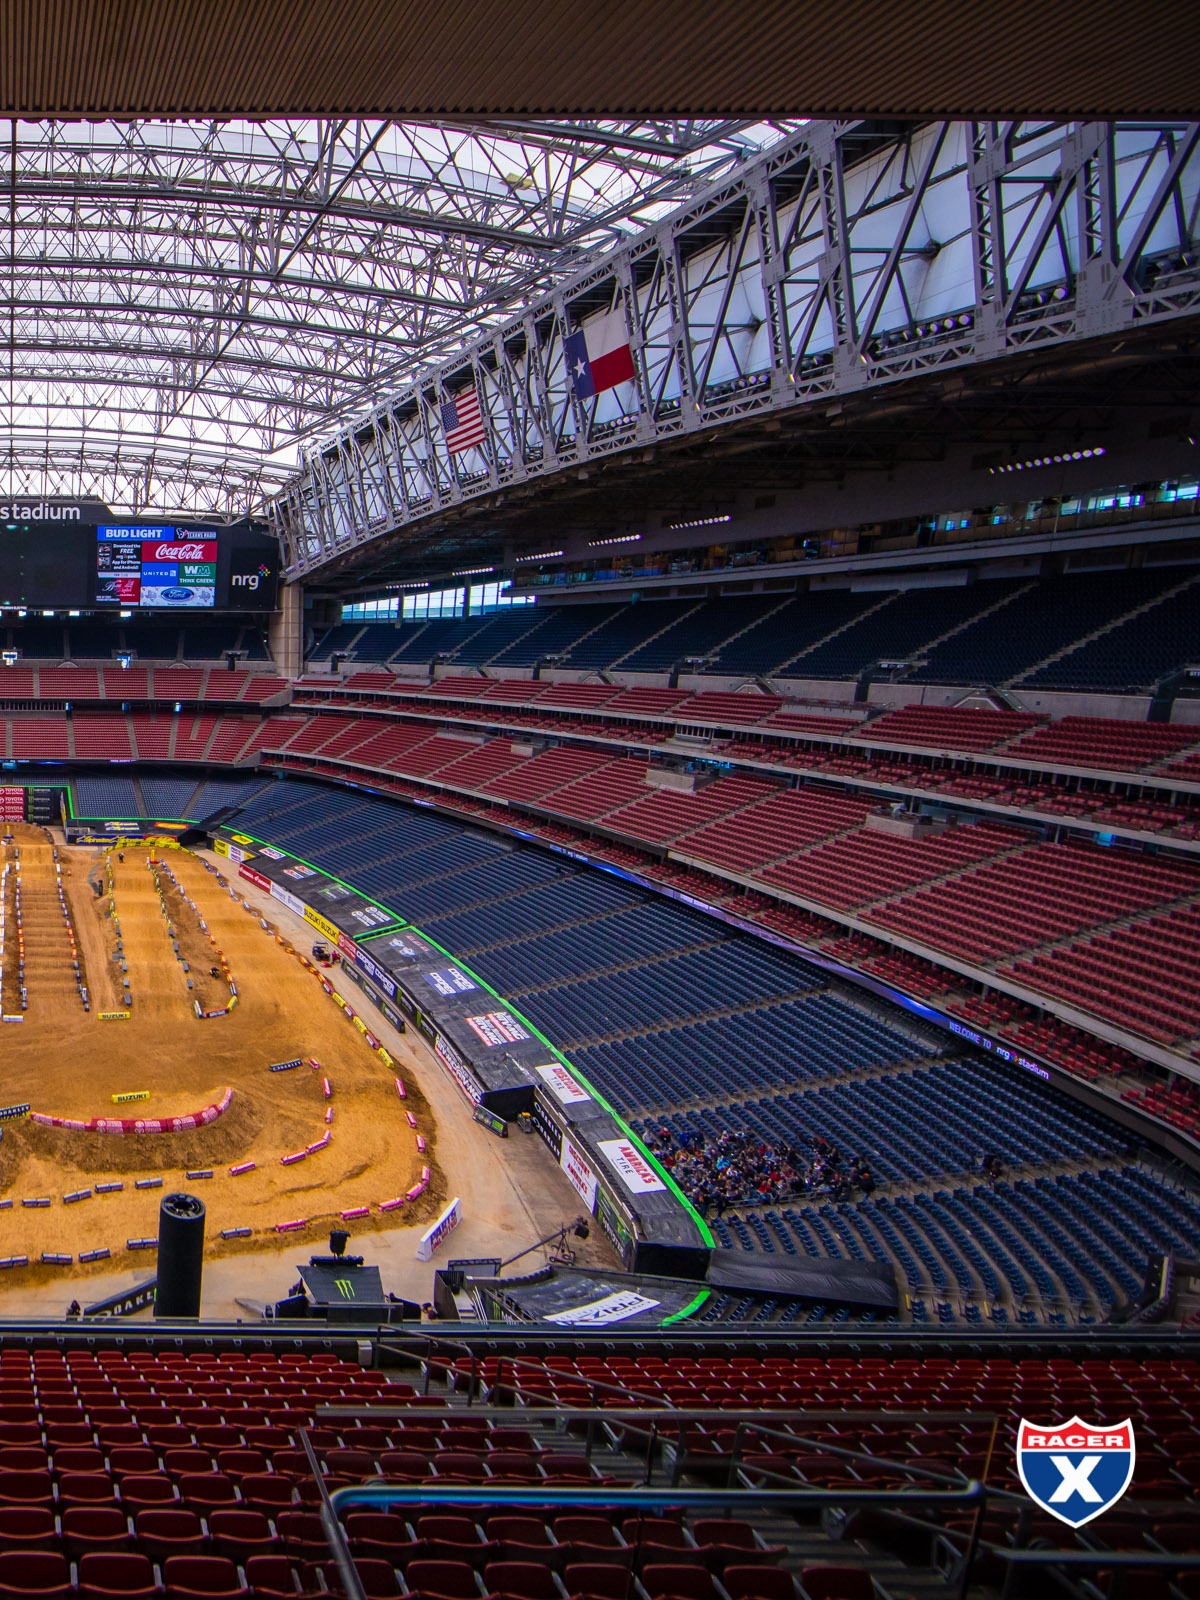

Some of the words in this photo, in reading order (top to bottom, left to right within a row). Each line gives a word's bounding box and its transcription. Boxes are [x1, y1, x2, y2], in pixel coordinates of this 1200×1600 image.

[0, 503, 80, 520] stadium
[106, 529, 130, 538] BUD
[130, 529, 162, 538] LIGHT
[232, 574, 259, 590] nrg
[357, 950, 375, 972] COOPER
[375, 968, 395, 990] COOPER
[429, 973, 456, 994] COOPER
[448, 968, 476, 989] COOPER
[949, 1021, 980, 1044] WELCOME
[982, 1038, 992, 1050] TO
[996, 1047, 1010, 1061] nrg
[1019, 1058, 1050, 1080] stadium
[552, 1068, 584, 1096] DISCOUNT
[552, 1076, 564, 1090] TIRE
[117, 1093, 147, 1102] SUZUKI
[617, 1157, 633, 1174] TIRE
[618, 1146, 657, 1184] AMERICA'S
[430, 1207, 456, 1245] PARTS
